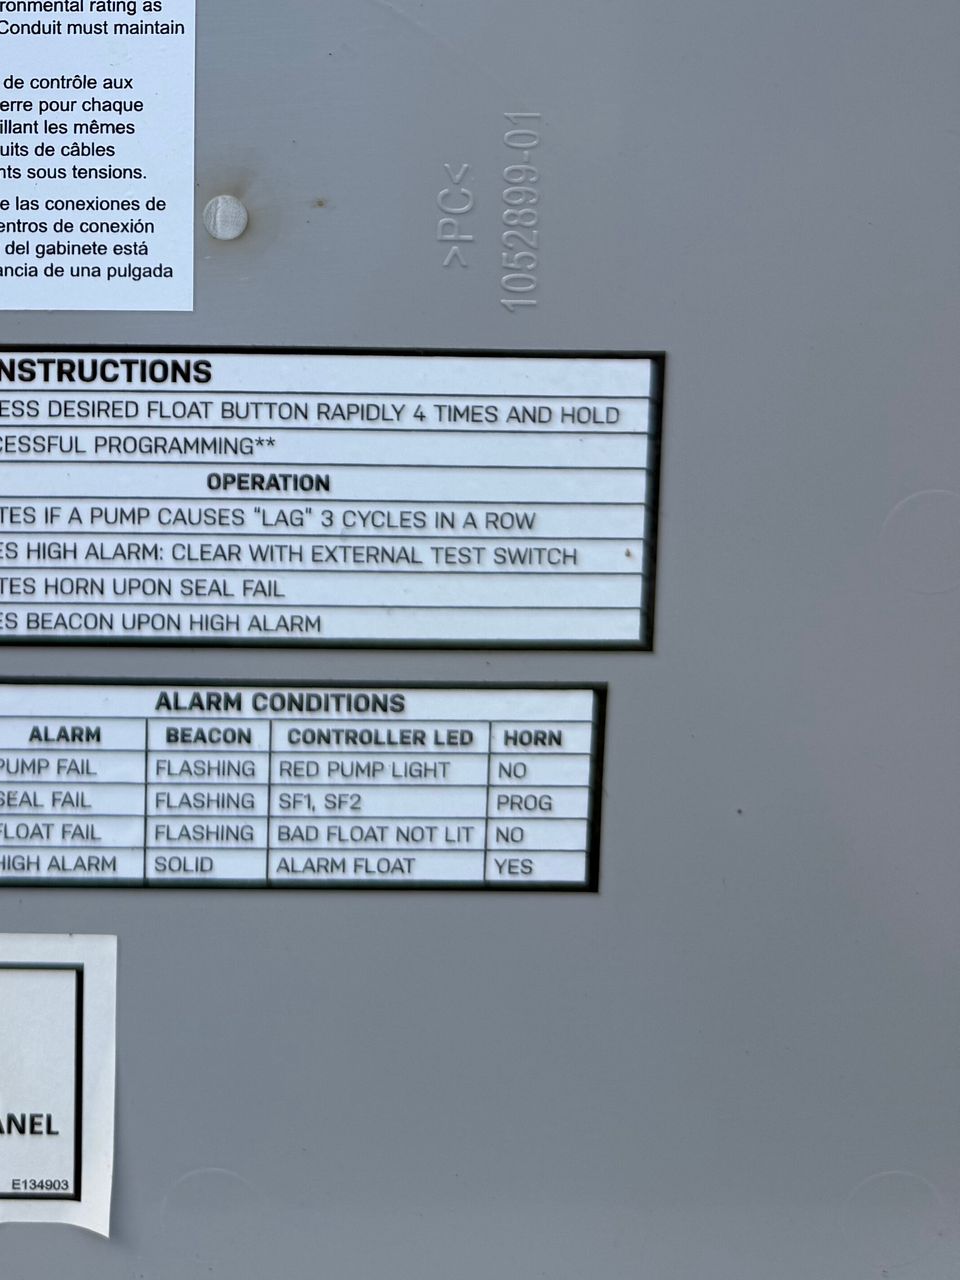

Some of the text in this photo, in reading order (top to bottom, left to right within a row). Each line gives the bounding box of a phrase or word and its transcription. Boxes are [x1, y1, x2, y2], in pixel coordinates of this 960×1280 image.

[500, 112, 541, 312] 1052899-01
[206, 472, 330, 492] OPERATION
[44, 506, 61, 525] IF
[67, 506, 83, 525] A
[90, 506, 150, 525] PUMP
[157, 507, 245, 527] CAUSES
[321, 509, 334, 528] 3
[342, 509, 427, 529] CYCLES
[435, 511, 455, 529] IN
[462, 511, 478, 530] A
[485, 511, 536, 530] ROW
[154, 691, 405, 714] ALARM CONDITIONS
[28, 726, 562, 747] ALARM BEACON CONTROLLER LED HORN
[56, 758, 97, 776] FAIL
[155, 759, 256, 778] FLASHING
[279, 760, 320, 778] RED
[327, 761, 385, 779] PUMP
[391, 761, 451, 779] LIGHT
[498, 762, 527, 780] NO
[11, 1178, 70, 1191] E134903
